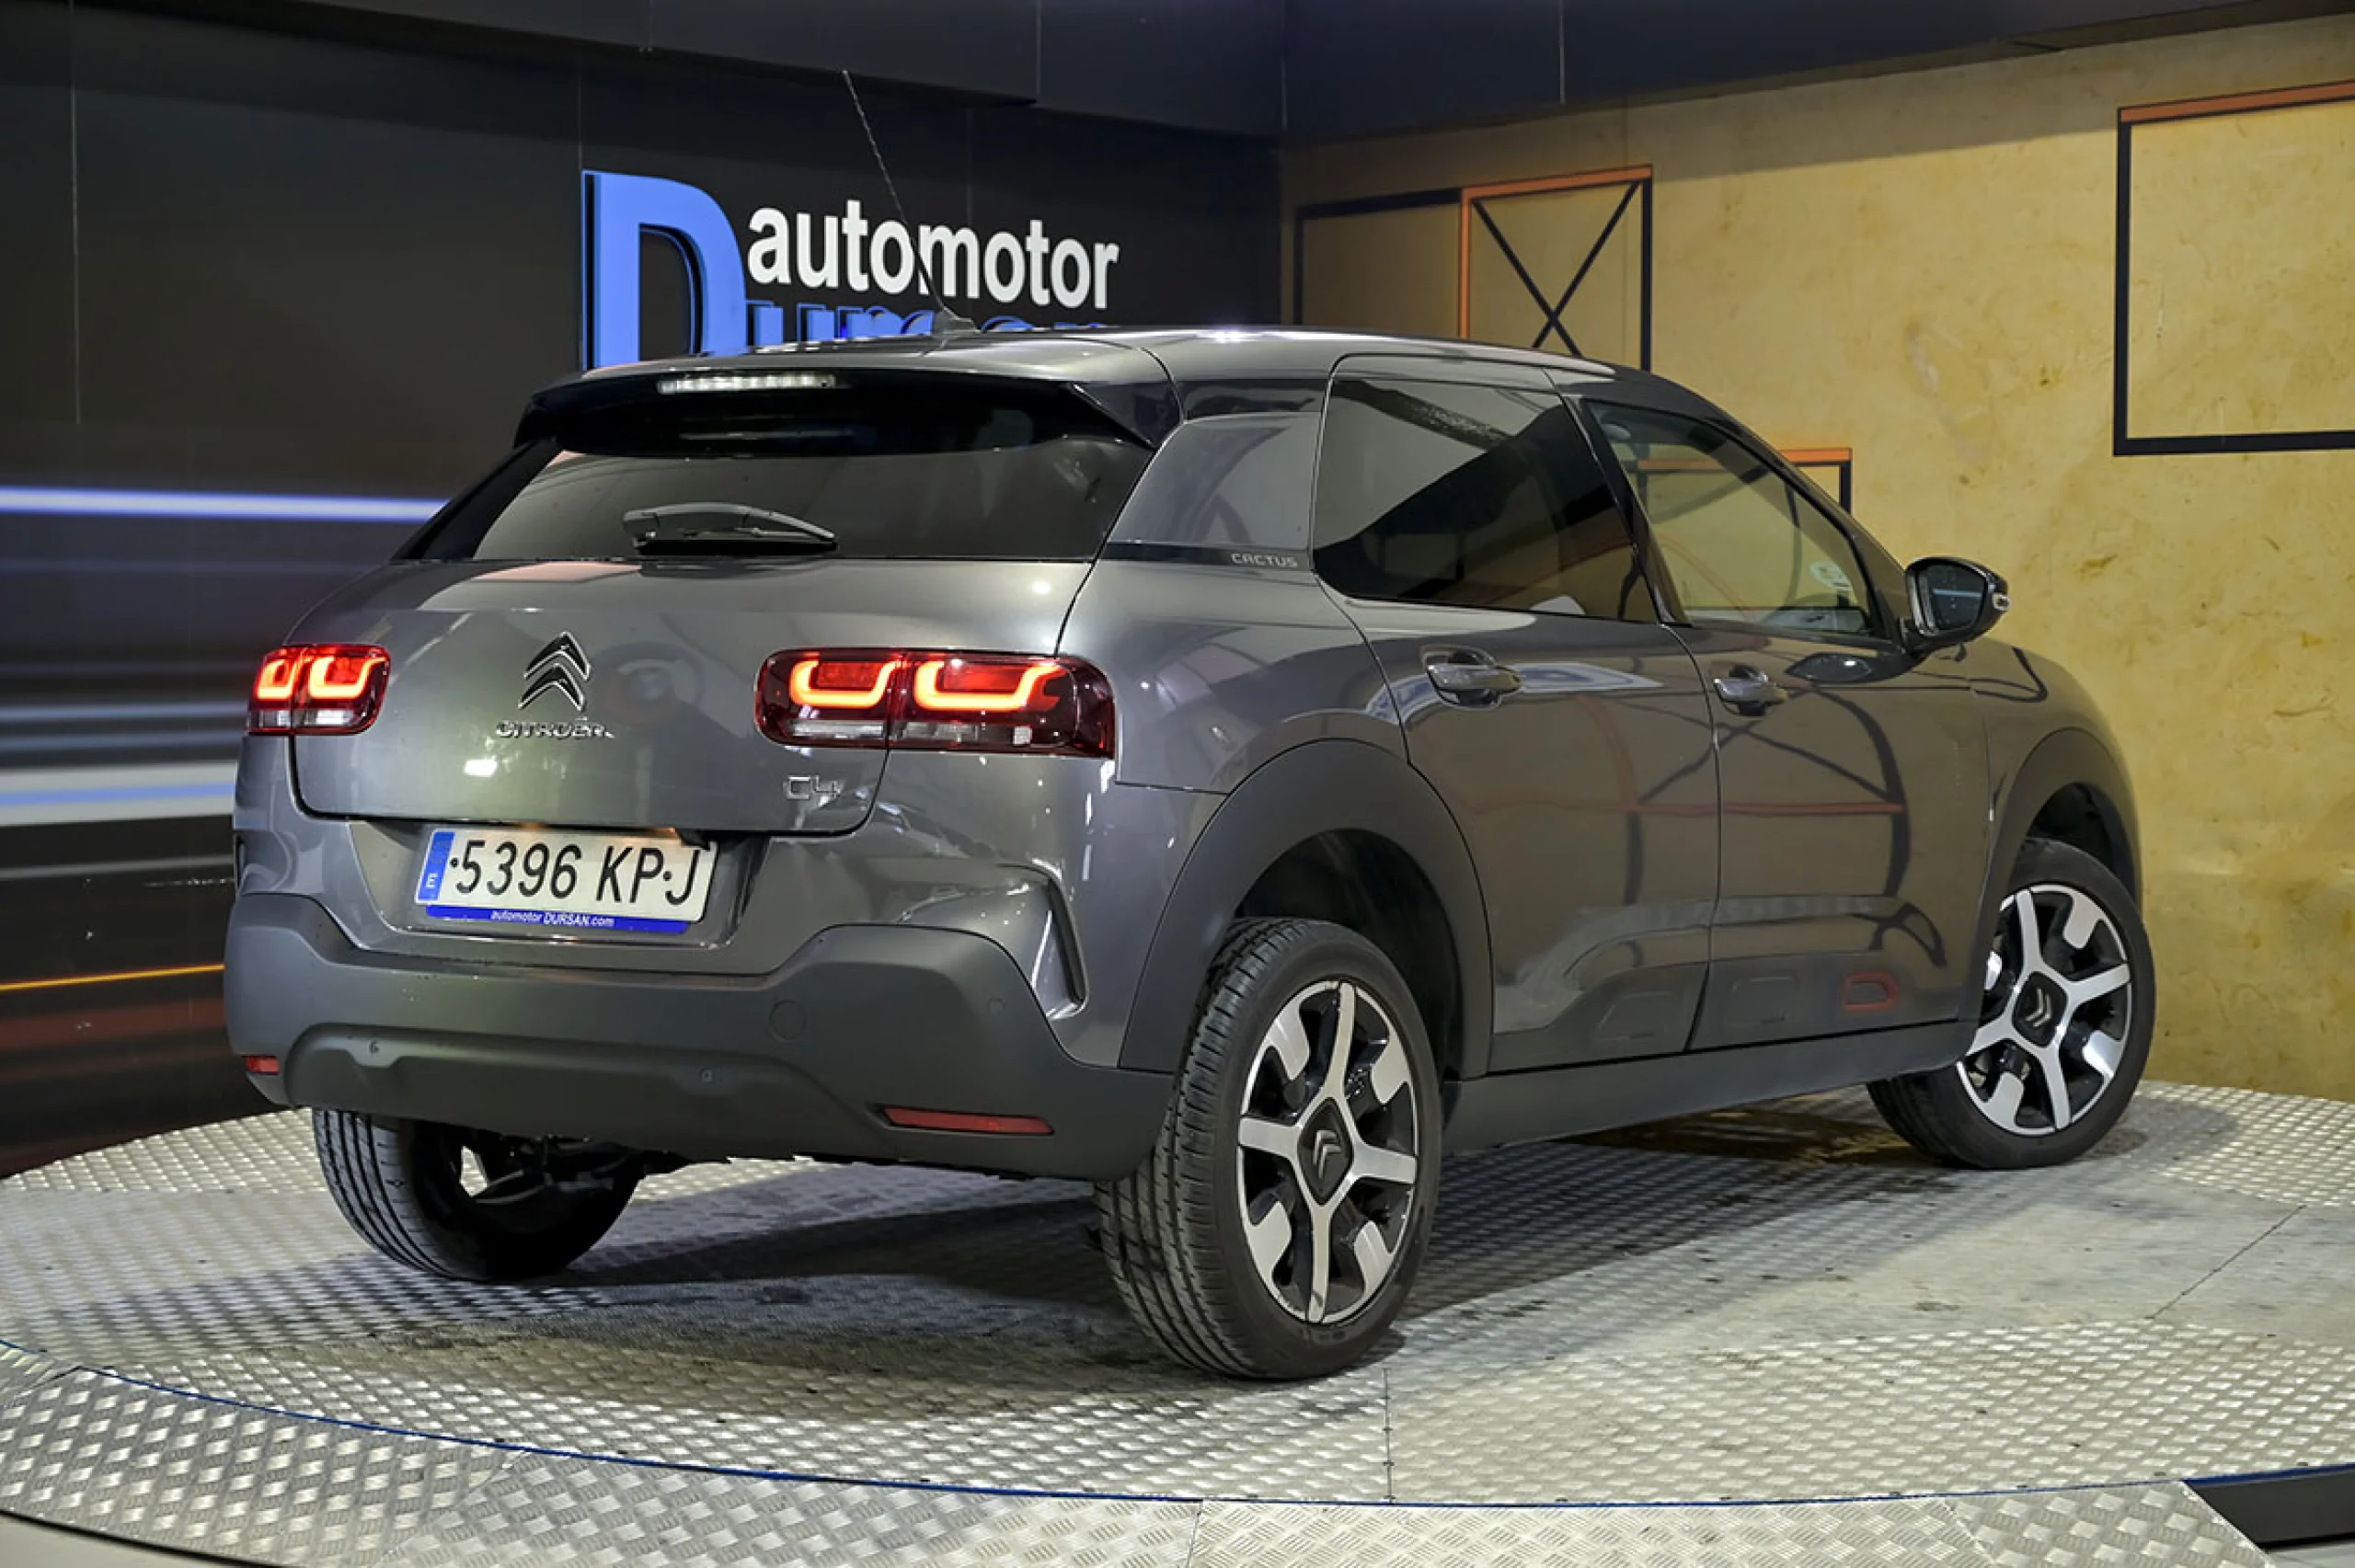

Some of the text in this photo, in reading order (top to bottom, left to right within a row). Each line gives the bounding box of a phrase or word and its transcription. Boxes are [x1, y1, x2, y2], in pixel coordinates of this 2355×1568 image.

[748, 200, 1120, 309] automotor
[1231, 553, 1298, 567] CACTUS
[787, 774, 842, 800] C4
[455, 840, 582, 899] 5396
[425, 873, 438, 888] E
[490, 910, 615, 926] automotor DURSAN.com
